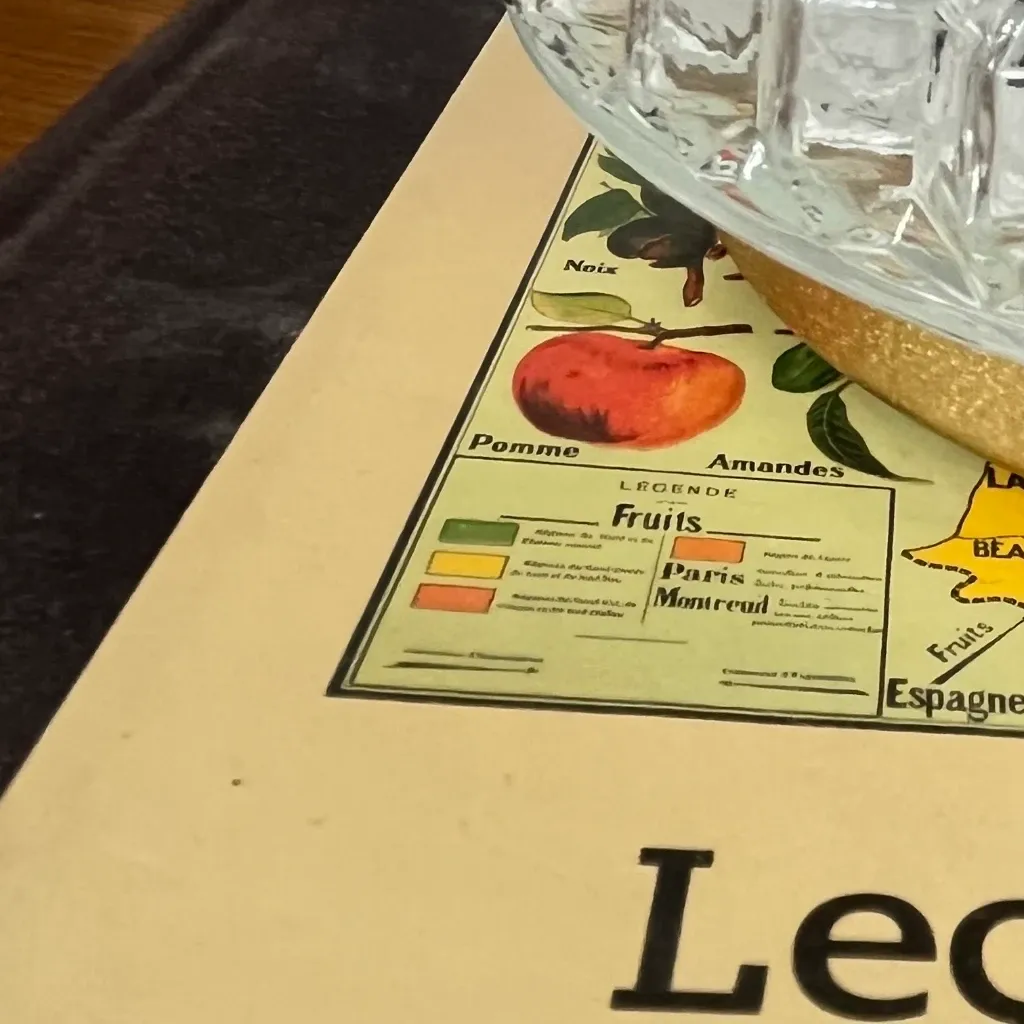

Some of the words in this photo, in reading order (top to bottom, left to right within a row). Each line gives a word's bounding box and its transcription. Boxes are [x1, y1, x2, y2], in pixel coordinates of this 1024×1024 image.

[563, 259, 620, 275] Noix
[467, 433, 580, 459] Pomme
[707, 453, 845, 478] Amandes
[612, 503, 702, 533] Fruits
[660, 562, 745, 585] Paris
[926, 622, 994, 663] Fruits
